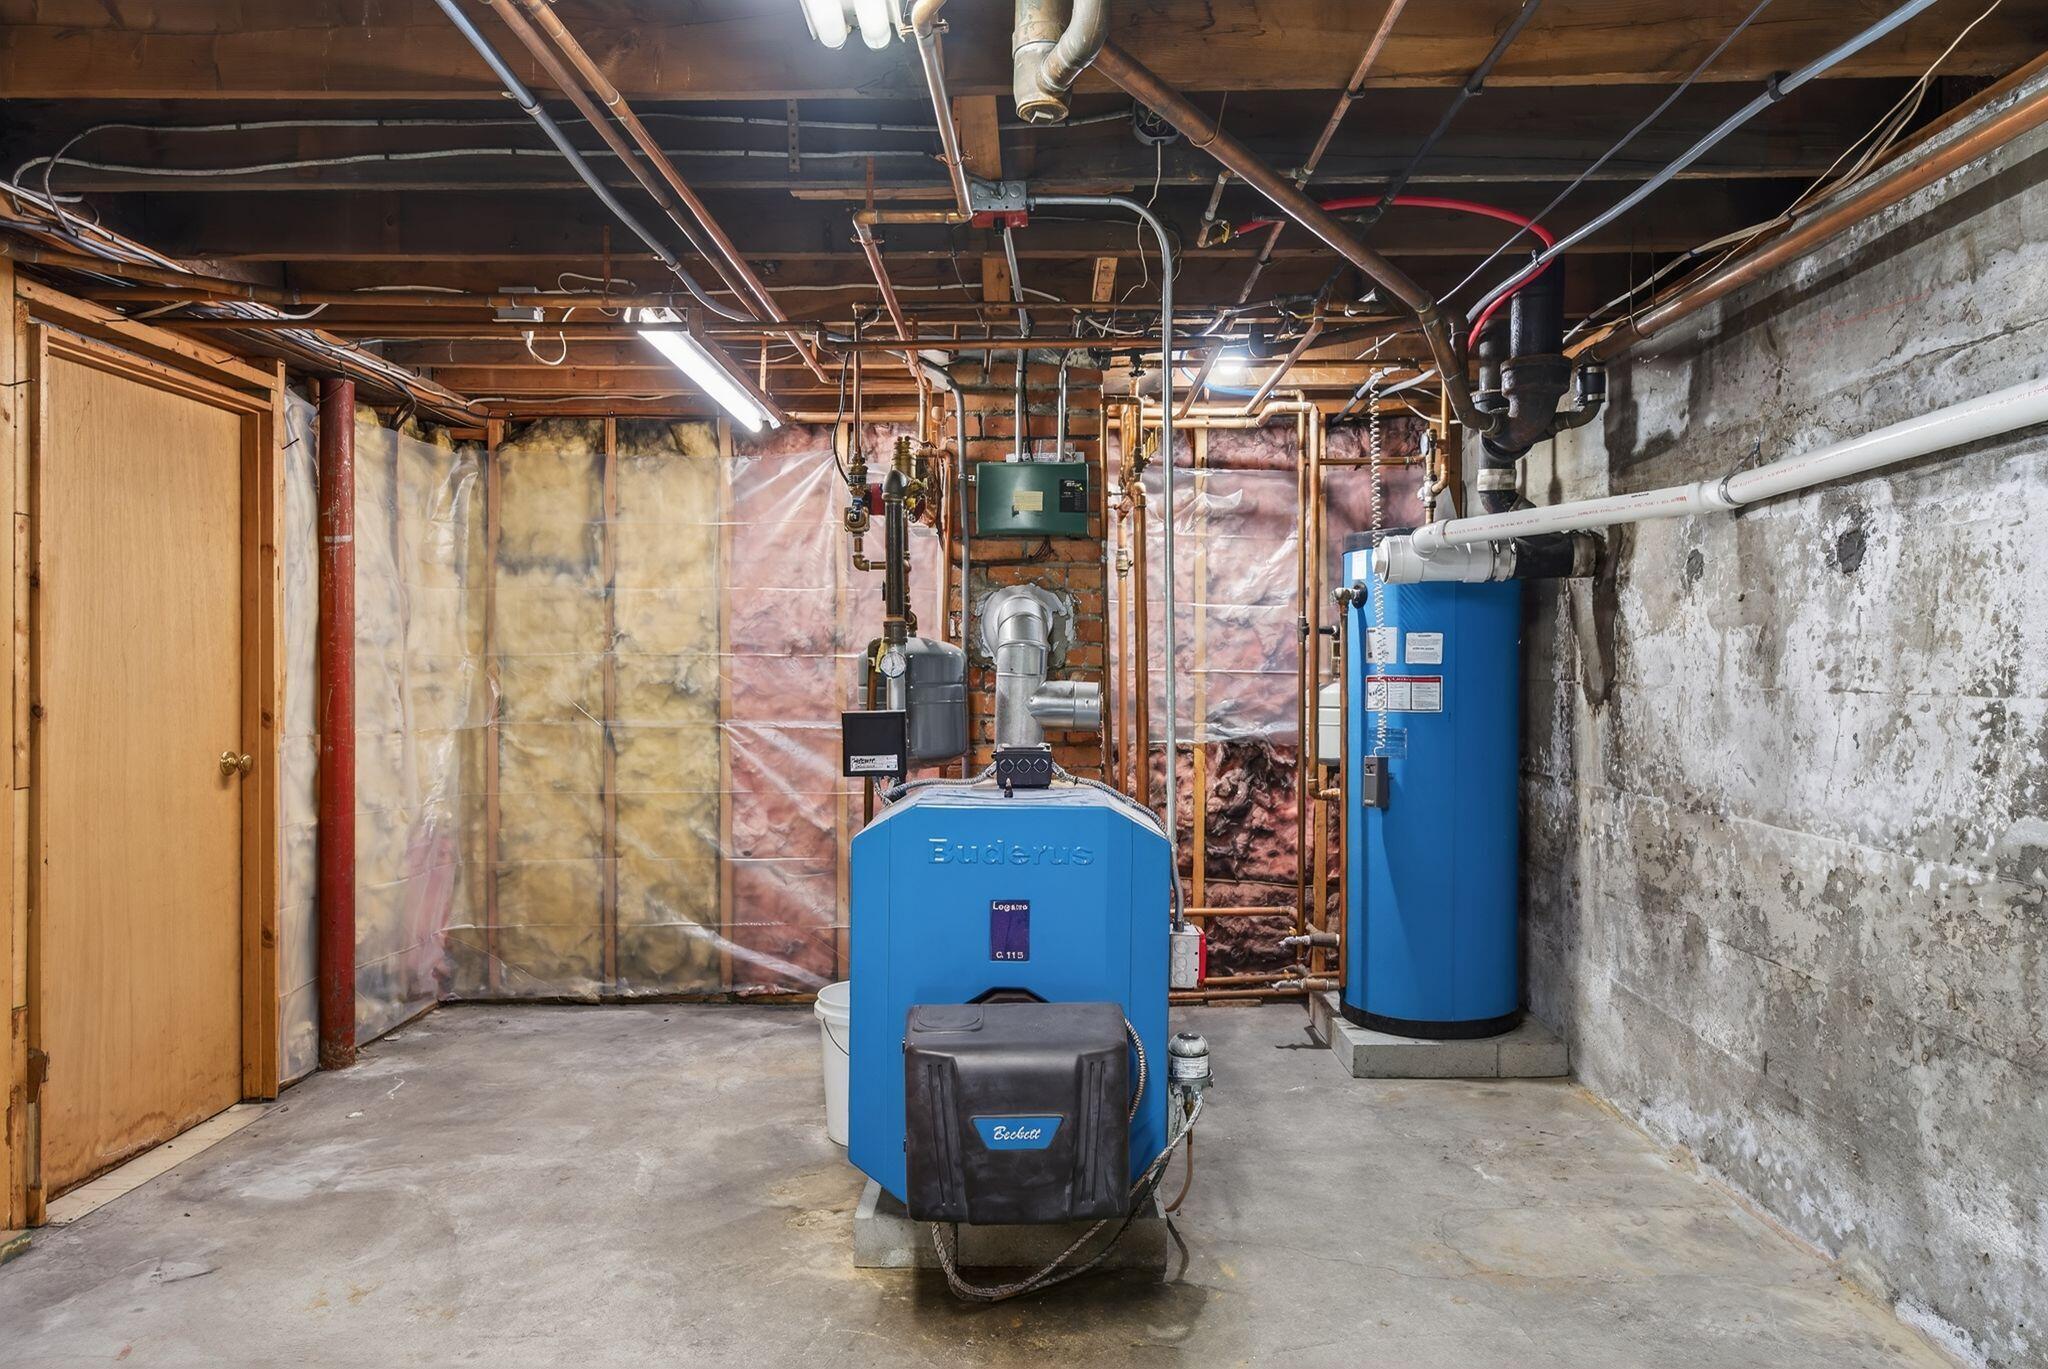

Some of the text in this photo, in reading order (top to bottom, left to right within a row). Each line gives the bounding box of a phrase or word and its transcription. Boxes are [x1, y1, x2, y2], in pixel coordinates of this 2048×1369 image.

[928, 838, 1095, 866] Buderus
[1006, 951, 1024, 959] 115
[993, 1125, 1041, 1140] Beckett
